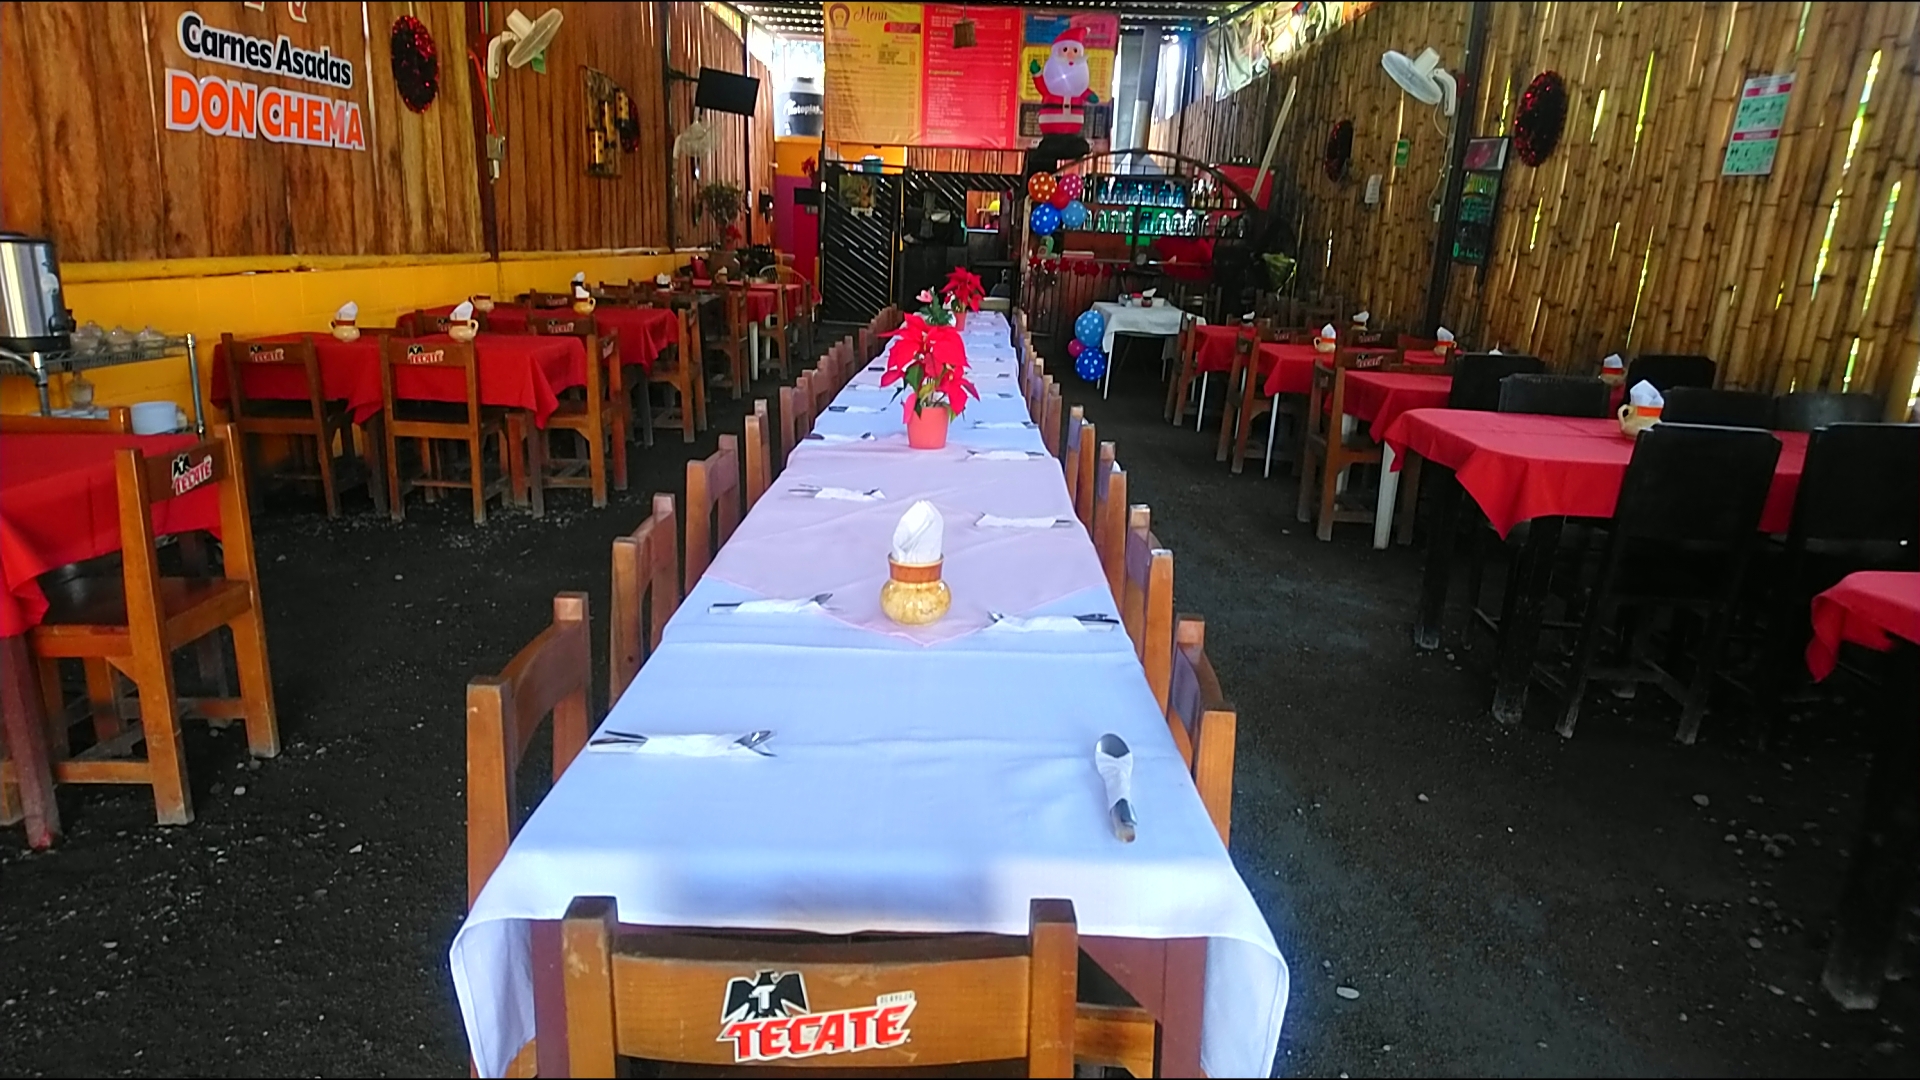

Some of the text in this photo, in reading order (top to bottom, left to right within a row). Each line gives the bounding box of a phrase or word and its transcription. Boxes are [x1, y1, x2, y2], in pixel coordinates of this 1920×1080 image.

[182, 14, 352, 86] Carnes Asadas
[171, 74, 363, 147] DON CHEMA
[174, 459, 212, 496] TECATE
[721, 1004, 911, 1061] TECATE
